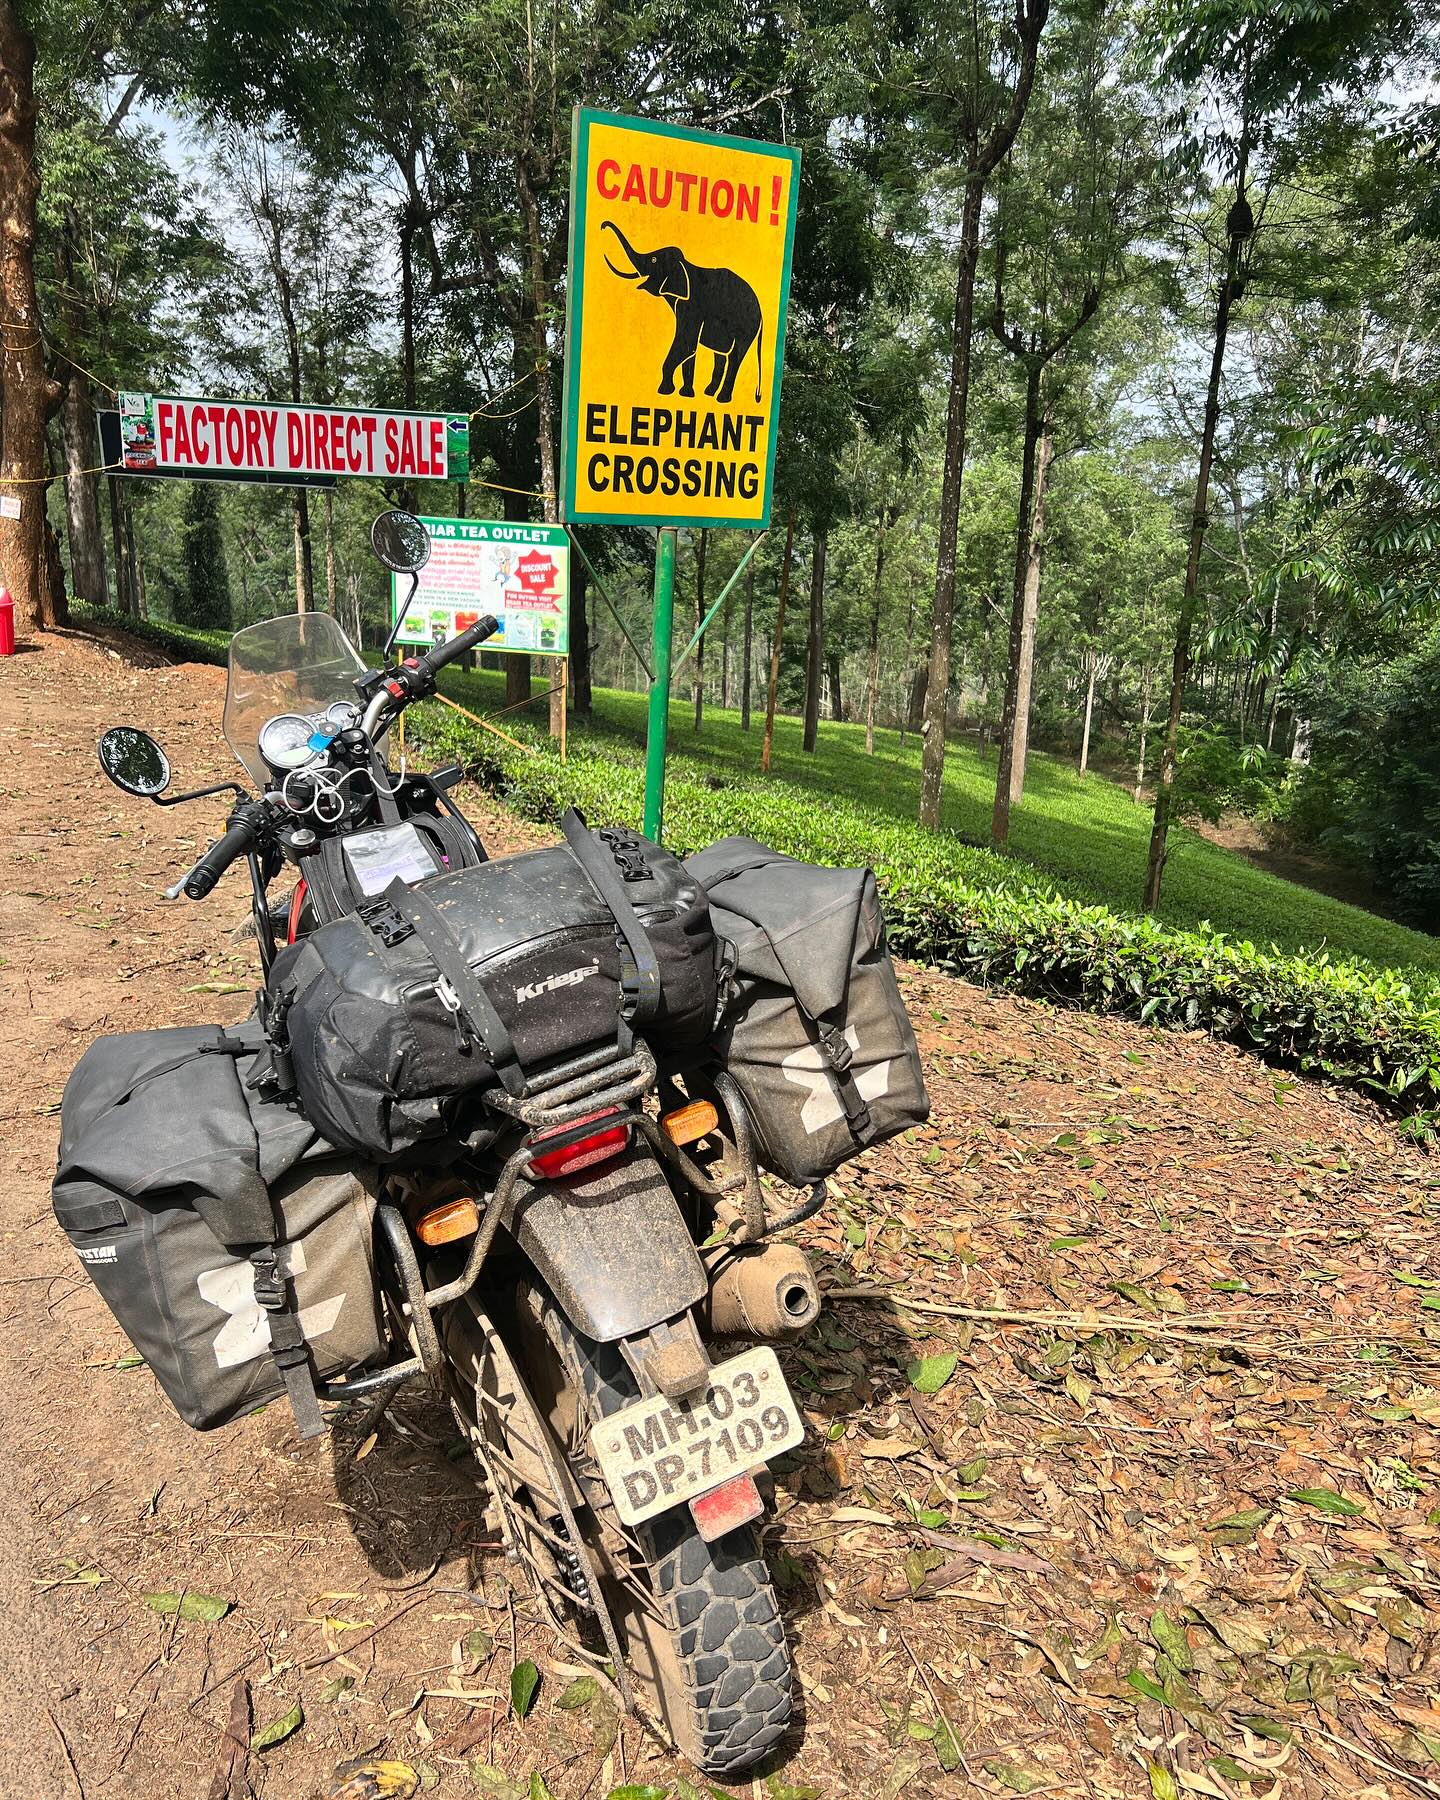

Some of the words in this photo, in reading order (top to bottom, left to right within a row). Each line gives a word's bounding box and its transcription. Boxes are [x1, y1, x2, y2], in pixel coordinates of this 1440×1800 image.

[596, 159, 761, 224] CAUTION
[769, 175, 782, 227] !
[157, 403, 279, 468] FACTORY
[287, 413, 377, 473] DIRECT
[385, 418, 445, 476] SALE
[585, 403, 765, 453] ELEPHANT
[587, 453, 759, 500] CROSSING
[460, 526, 488, 539] TEA
[492, 528, 550, 542] OUTLET
[521, 563, 551, 573] DISCOUNT
[530, 574, 546, 583] SALE
[516, 965, 599, 1004] Kriega
[623, 1372, 761, 1462] MH.03
[622, 1405, 790, 1512] DP.7109
